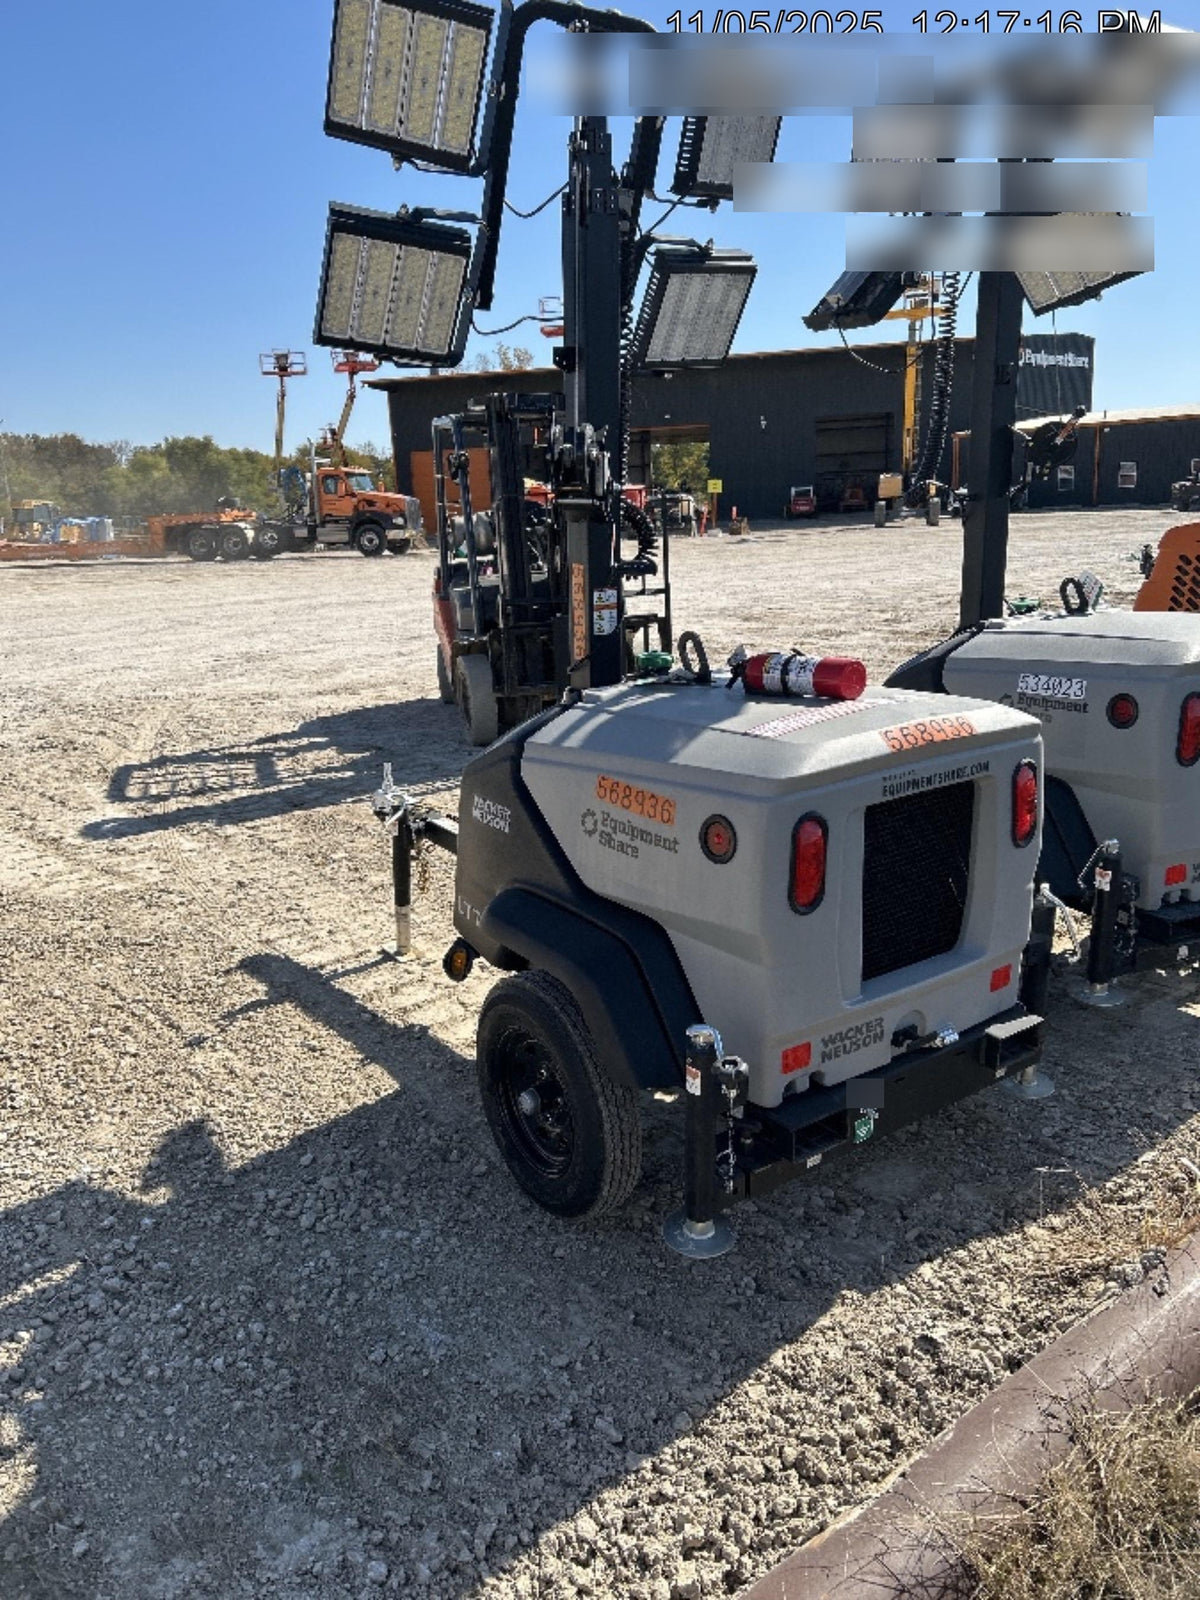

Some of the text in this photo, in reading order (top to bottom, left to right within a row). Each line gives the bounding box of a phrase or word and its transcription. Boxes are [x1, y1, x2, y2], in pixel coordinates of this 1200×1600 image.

[1019, 674, 1085, 699] 534023
[883, 716, 974, 751] 568936
[597, 776, 673, 824] 568936
[598, 829, 639, 859] Share
[600, 810, 680, 854] Equipment
[820, 1029, 885, 1064] NEUSON
[821, 1017, 885, 1049] WACKER
